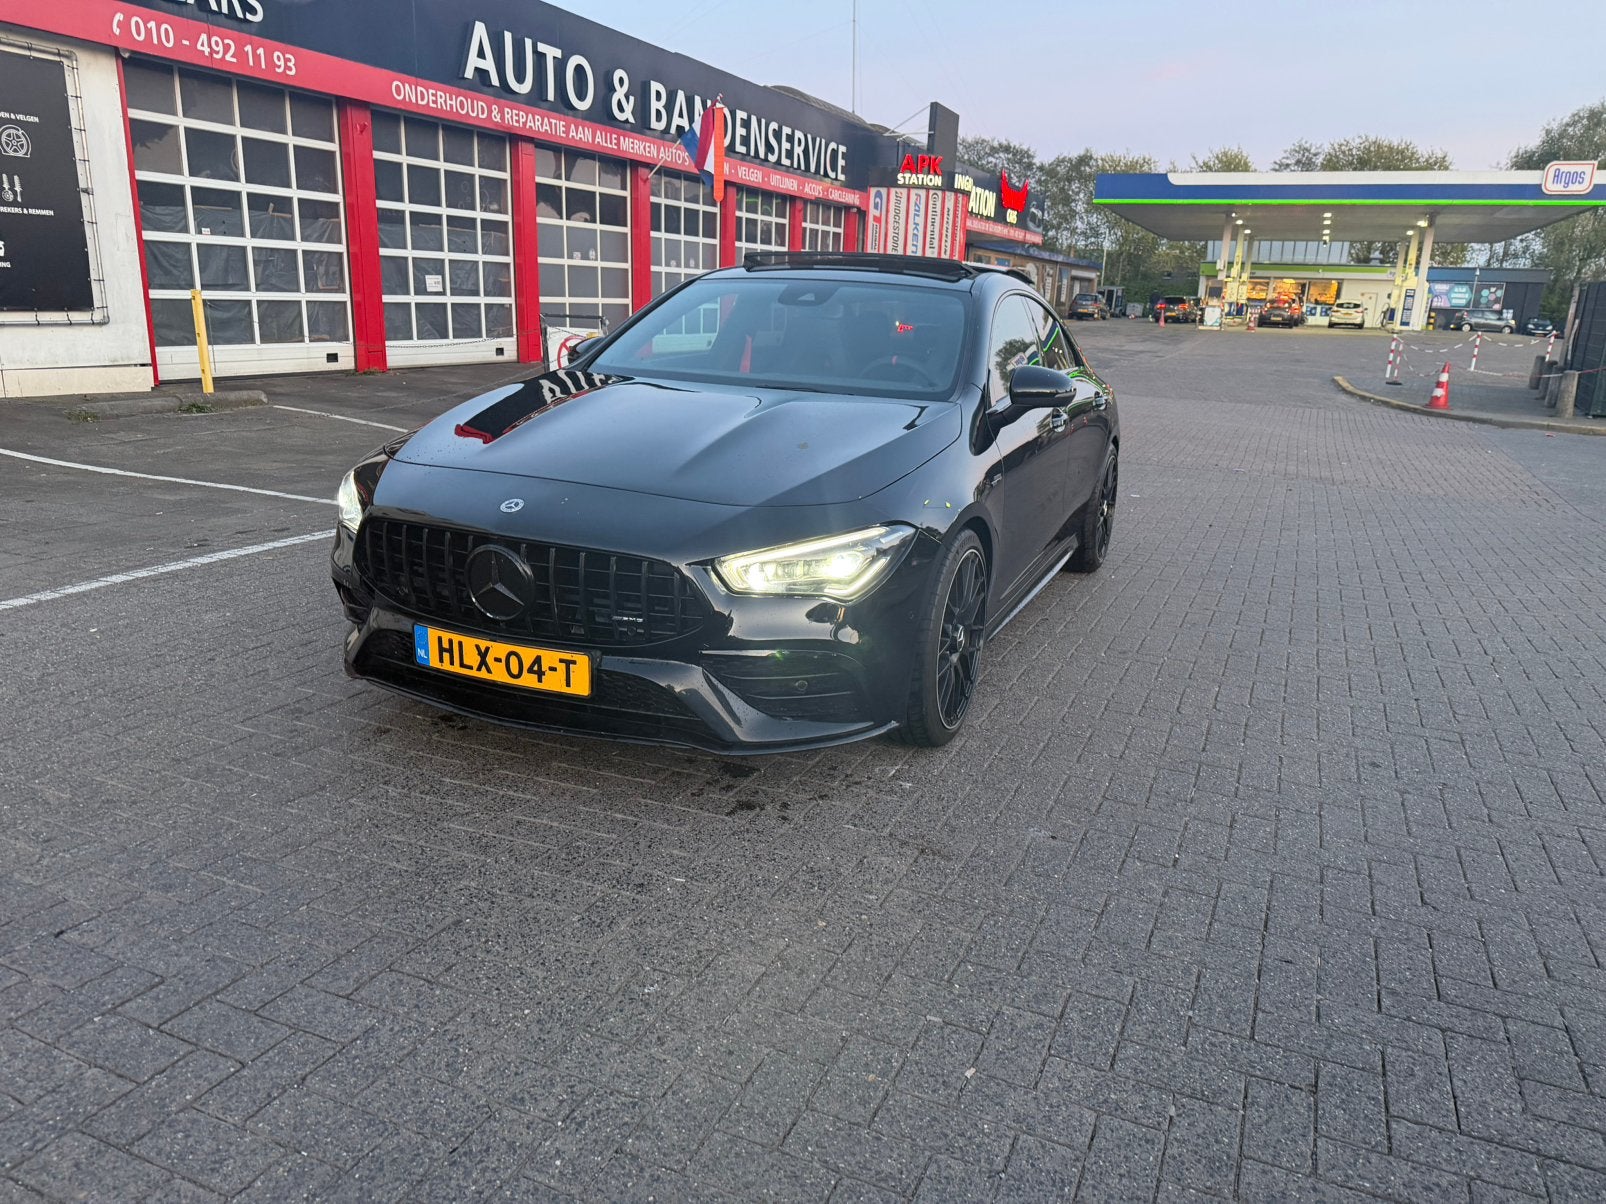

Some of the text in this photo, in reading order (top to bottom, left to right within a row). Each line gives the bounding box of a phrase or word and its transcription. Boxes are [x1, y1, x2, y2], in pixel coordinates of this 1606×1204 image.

[130, 16, 175, 48] 010
[196, 33, 237, 63] 492
[244, 44, 266, 69] 11
[273, 51, 297, 76] 93
[464, 21, 595, 111] AUTO
[611, 69, 636, 123] &
[391, 80, 690, 166] ONDERHOUD & REPARATIE AAN ALLE MERKEN AUTO'S
[737, 165, 762, 183] VELGEN
[897, 172, 942, 187] STATION
[900, 153, 943, 176] APK
[1552, 168, 1586, 188] Argos
[892, 189, 903, 254] BRIDGESTONE
[911, 192, 922, 255] FALKEN
[929, 192, 940, 250] Continental
[417, 648, 428, 659] NL
[437, 636, 577, 688] HLX-04-T
